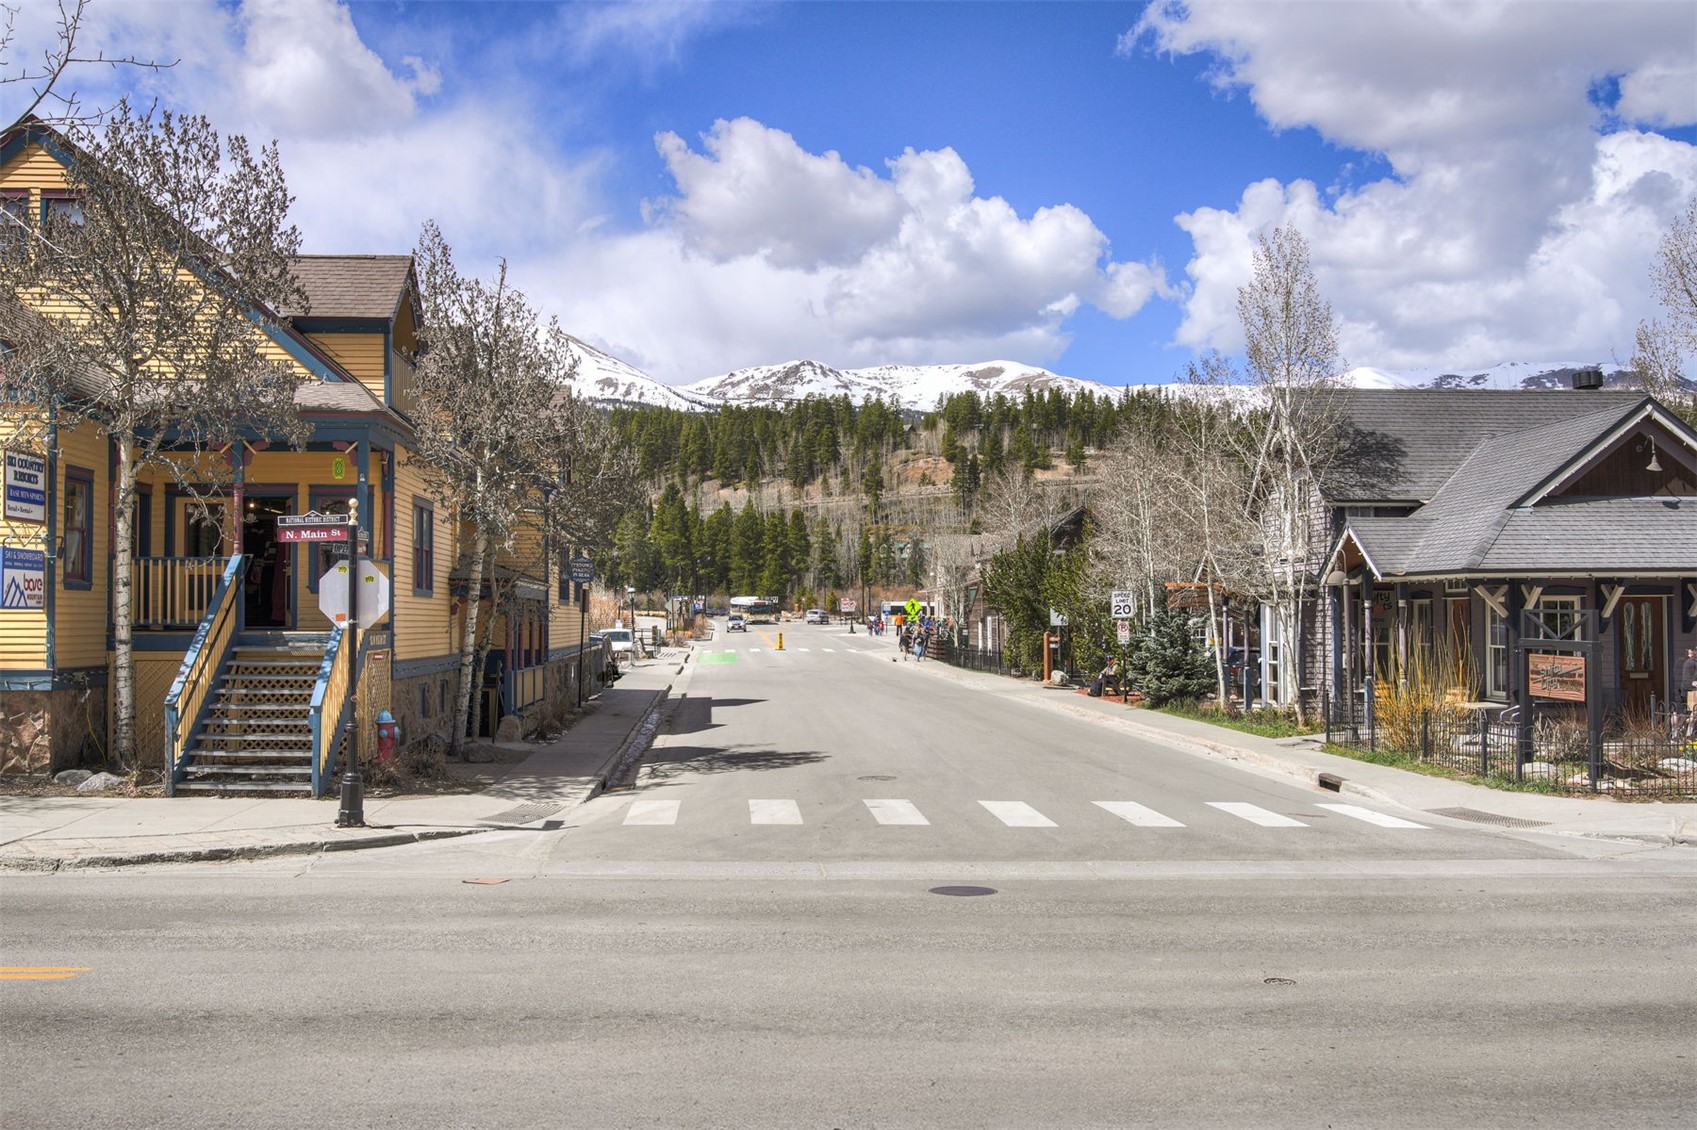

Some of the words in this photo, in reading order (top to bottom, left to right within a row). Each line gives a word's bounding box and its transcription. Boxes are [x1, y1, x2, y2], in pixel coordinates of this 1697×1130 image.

[18, 459, 44, 473] COUNTRY
[14, 470, 39, 485] RESORTS
[29, 492, 44, 502] SPORTS
[286, 516, 304, 524] NATIONAL
[286, 531, 297, 539] N.
[301, 530, 327, 538] Main
[17, 551, 43, 561] SNOWBOARD
[1114, 604, 1131, 615] 20
